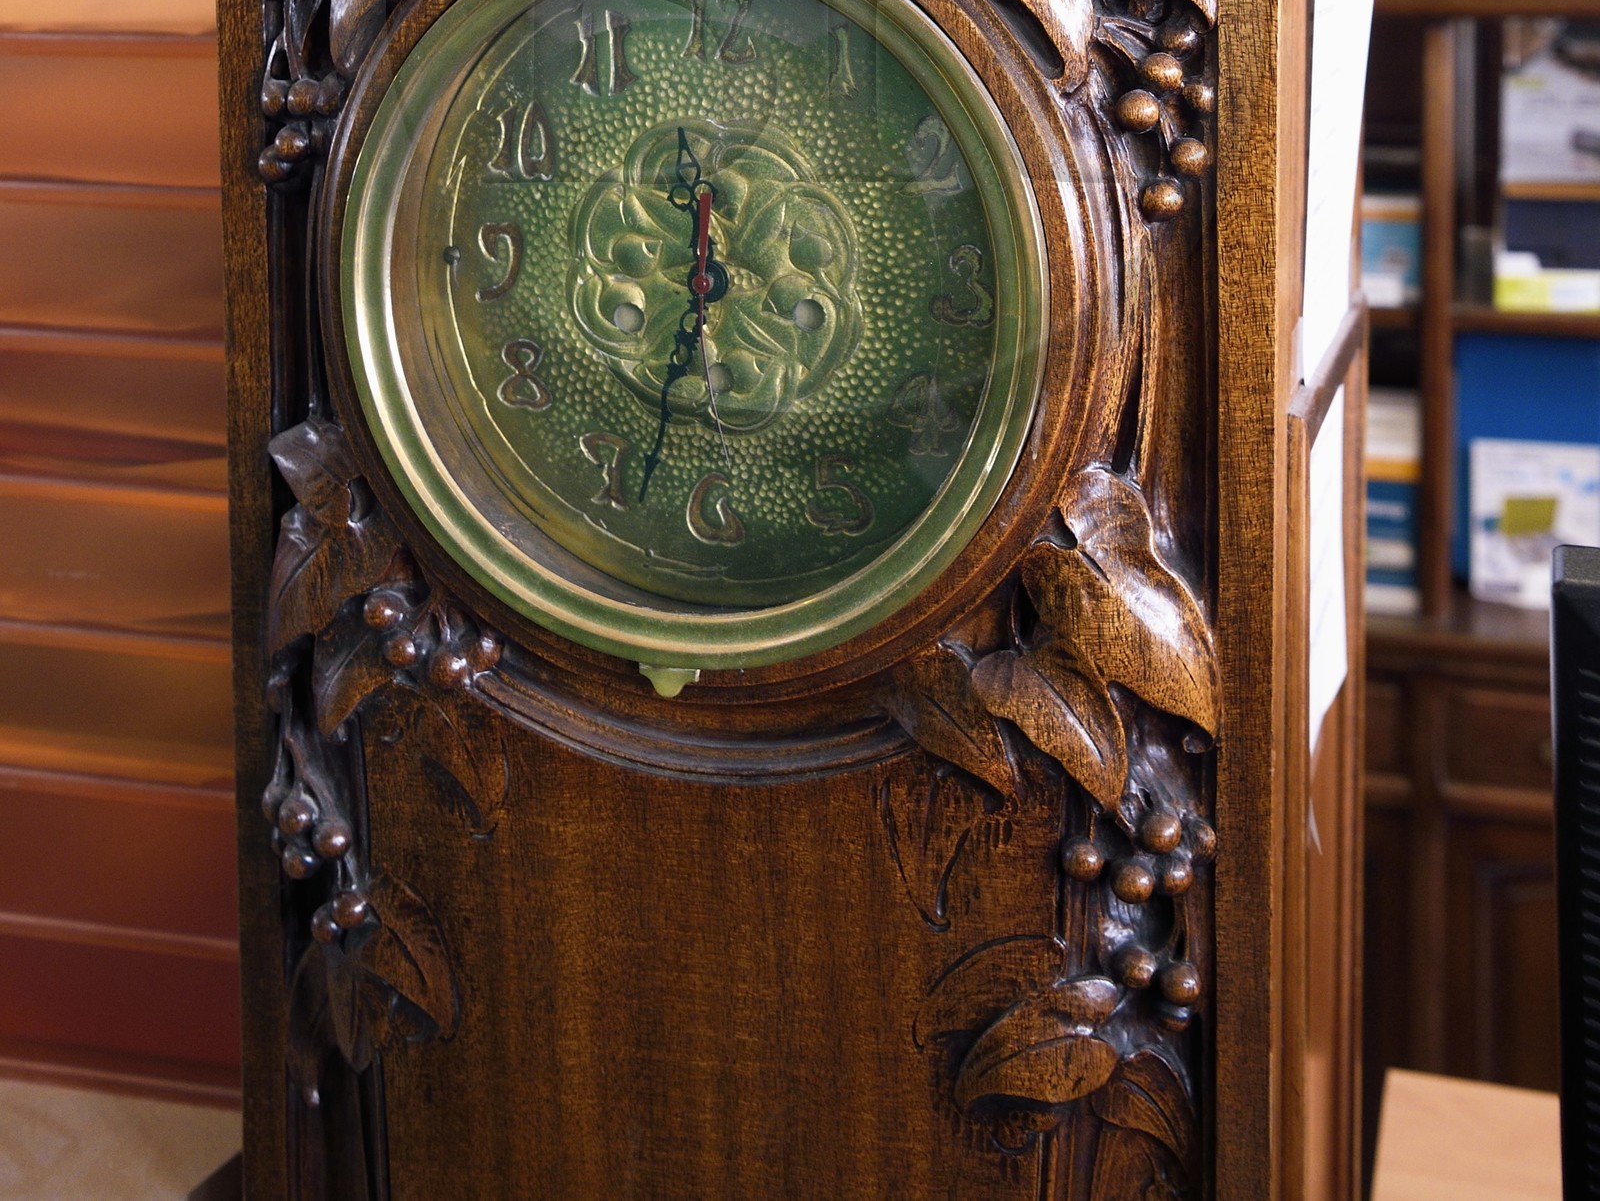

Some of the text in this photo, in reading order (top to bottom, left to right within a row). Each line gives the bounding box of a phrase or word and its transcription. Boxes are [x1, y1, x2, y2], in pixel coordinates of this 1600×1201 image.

[569, 8, 637, 97] 11
[487, 101, 556, 182] 10
[902, 114, 965, 196] 2
[476, 222, 524, 300] 9
[928, 245, 996, 329] 3
[497, 339, 554, 412] 8
[686, 472, 747, 546] 6
[804, 453, 876, 537] 5
